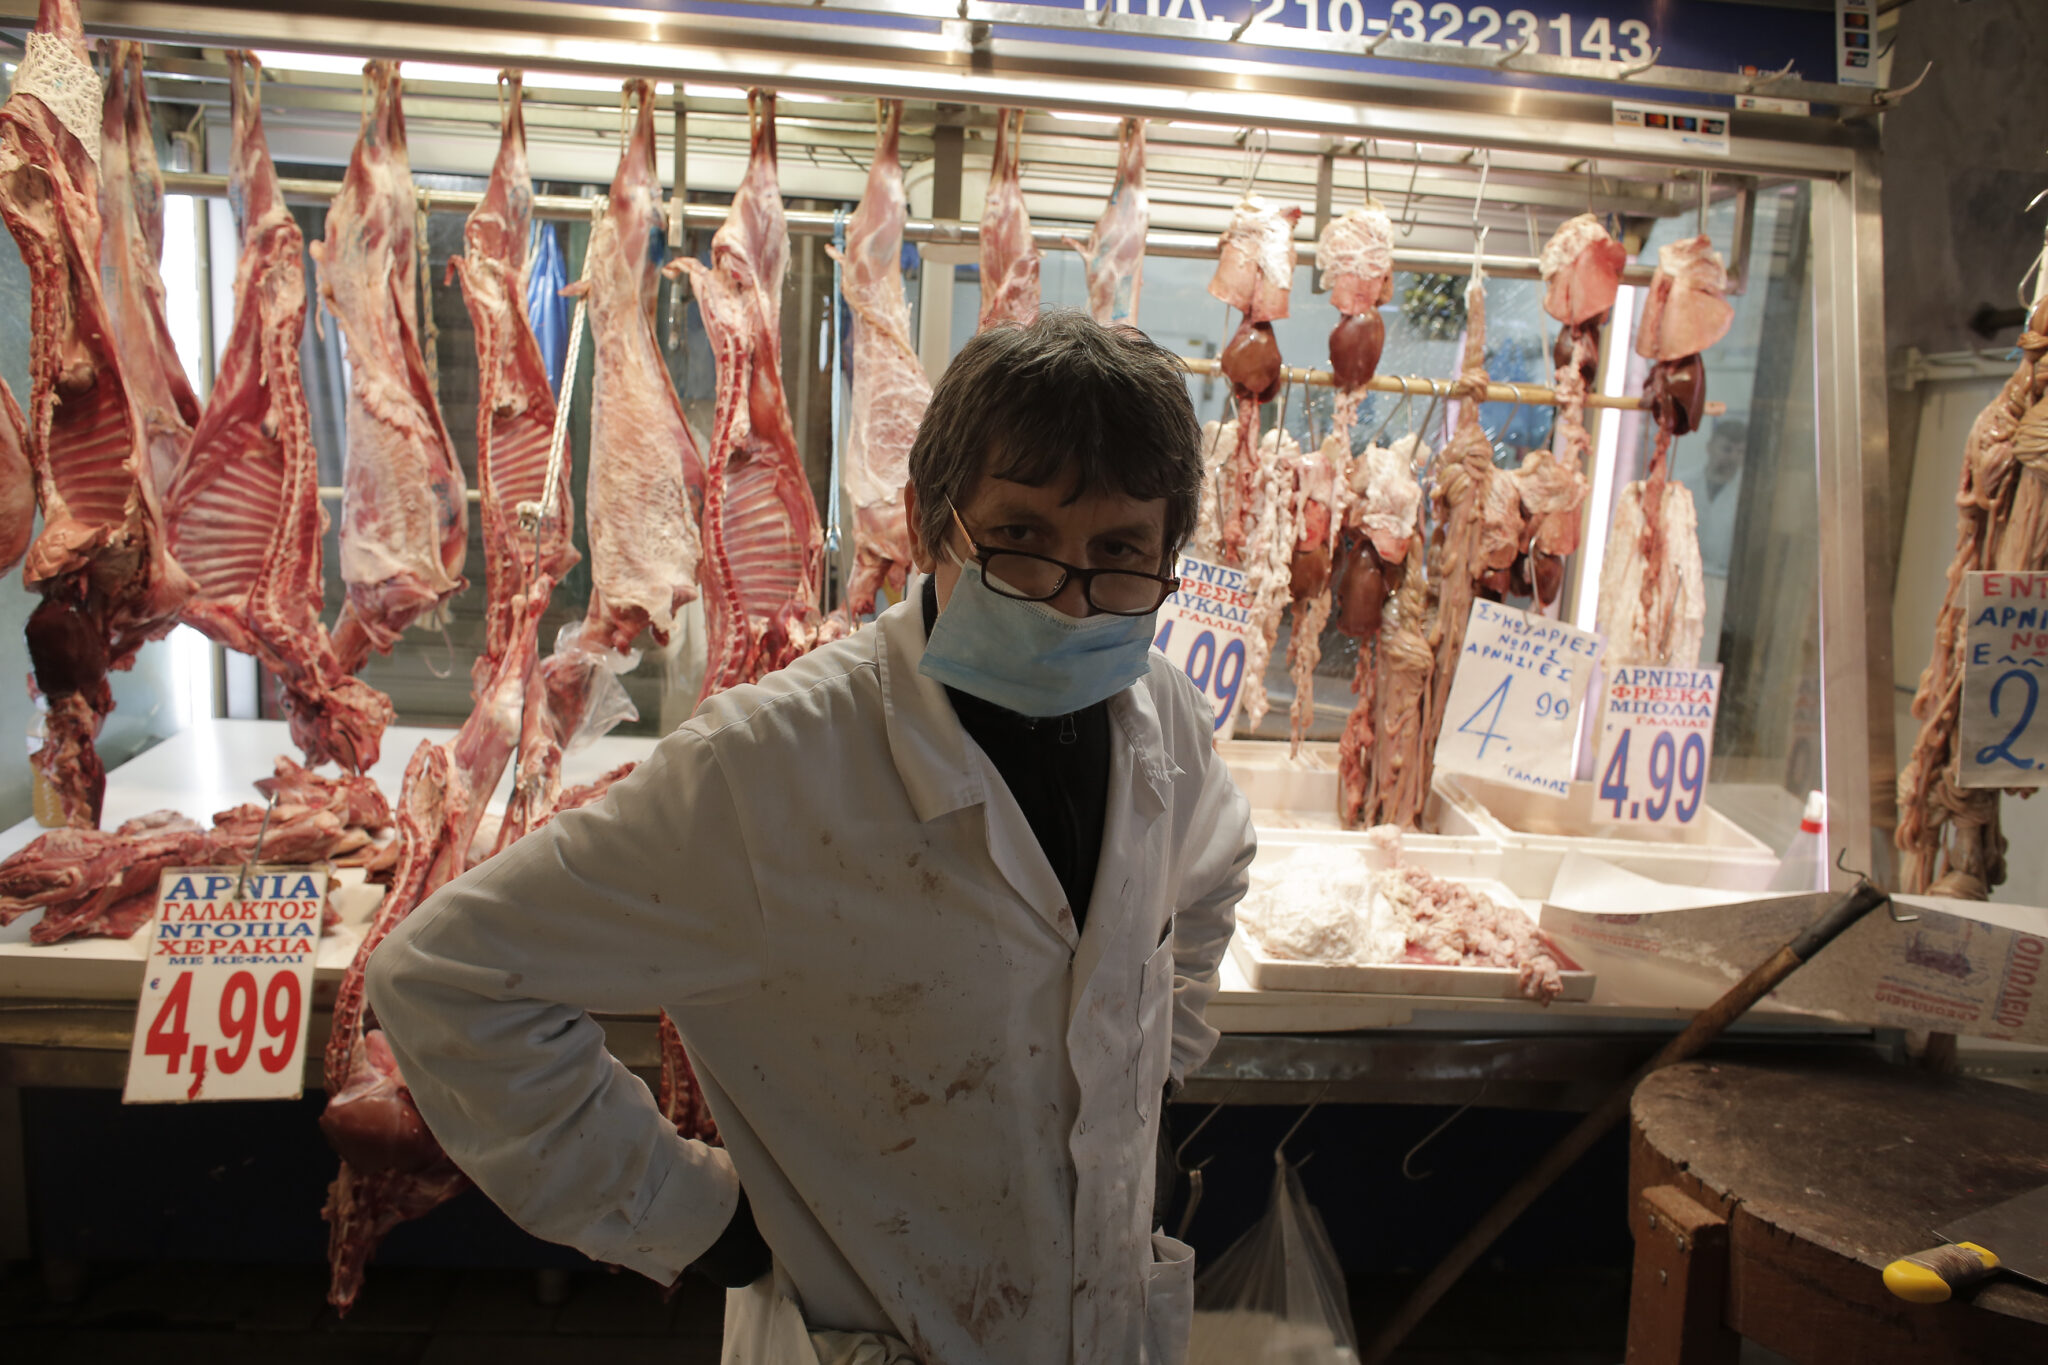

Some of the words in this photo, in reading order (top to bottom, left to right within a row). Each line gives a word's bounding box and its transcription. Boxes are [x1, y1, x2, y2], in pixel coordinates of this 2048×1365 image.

[1248, 0, 1653, 63] 210-3223143
[1181, 558, 1248, 592] ΡΝΙΣ
[1180, 577, 1253, 609] ΡΕΣΚ
[1498, 633, 1560, 665] ΝΩΠΕΣ
[1466, 642, 1573, 682] ΑΡΝΗΣΙΕΣ
[1613, 668, 1714, 690] ΑΡΝΙΣΙΑ
[1611, 685, 1712, 704] ΦΡΕΣΚΑ
[1609, 700, 1712, 718] ΜΠΟΛΙΑ
[1599, 728, 1705, 823] 4.99
[164, 875, 320, 900] ΑΡΝΙΑ
[161, 901, 317, 922] ΓΑΛΑΚΤΟΣ
[157, 922, 314, 939] ΝΤΟΠΙΑ
[154, 938, 313, 956] ΧΕΡΑΚΙΑ
[168, 956, 204, 966] ΜΕ
[212, 955, 304, 965] ΚΕΦΑΛΙ
[144, 970, 301, 1100] 4,99
